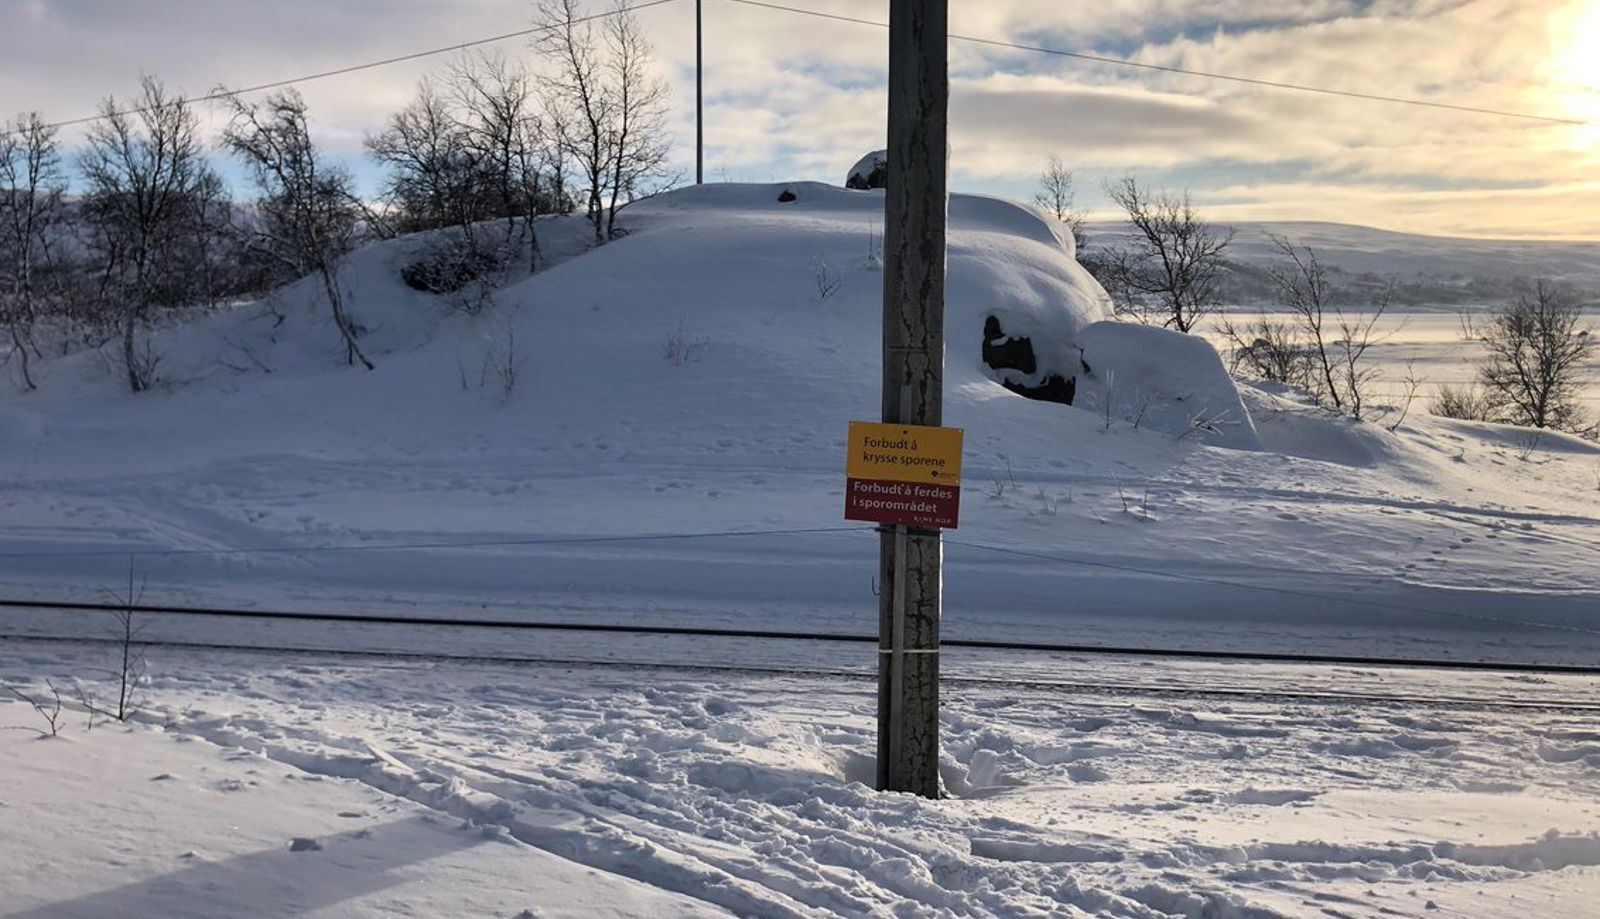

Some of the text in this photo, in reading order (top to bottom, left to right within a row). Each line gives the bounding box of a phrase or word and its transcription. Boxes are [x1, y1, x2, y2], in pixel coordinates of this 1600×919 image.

[864, 436, 918, 450] Forbudt å
[863, 451, 945, 467] krysse sporene
[854, 482, 953, 499] Forbudt å ferdes
[859, 498, 938, 513] sporområdet
